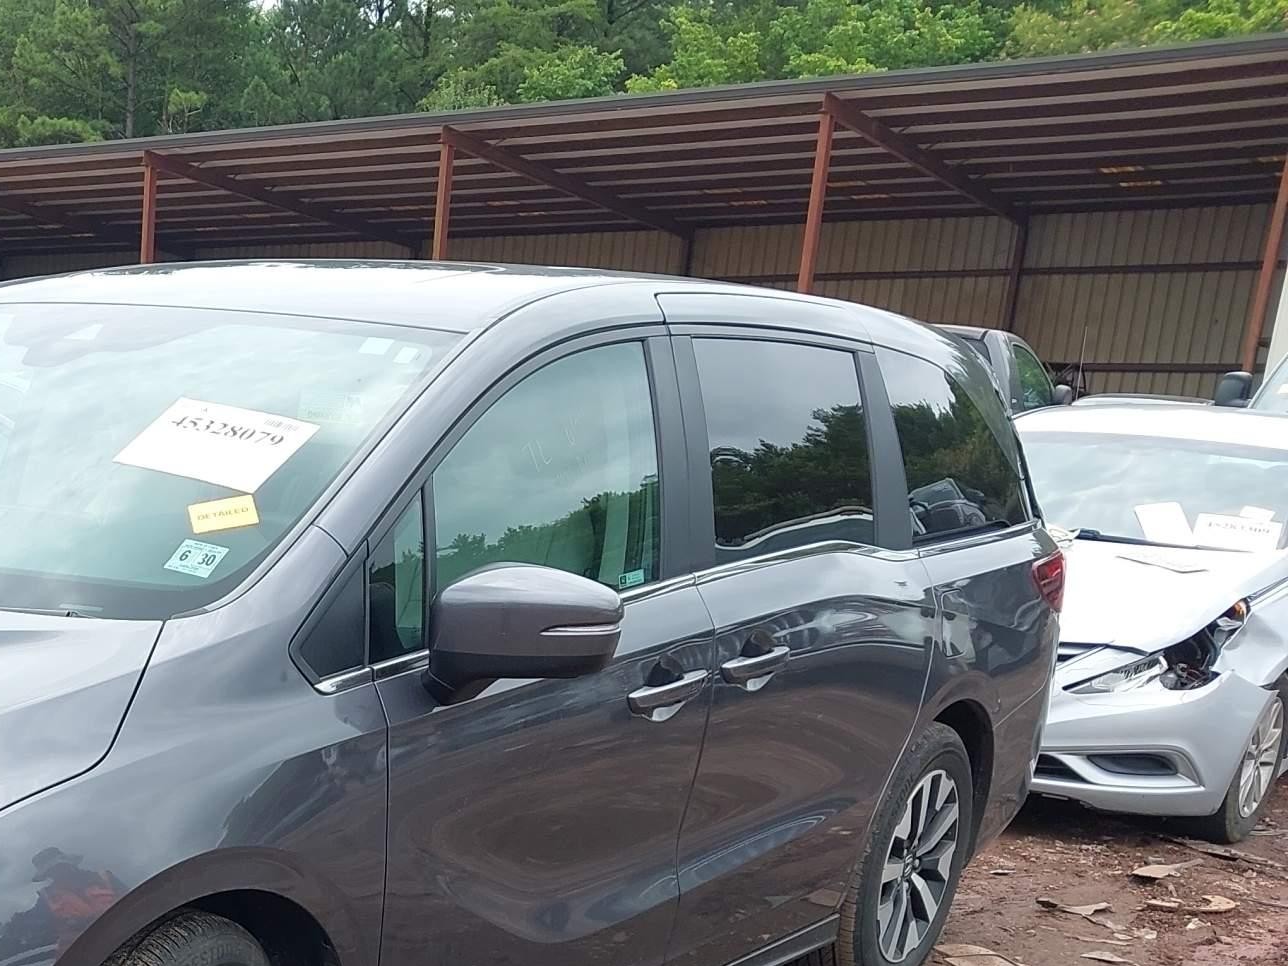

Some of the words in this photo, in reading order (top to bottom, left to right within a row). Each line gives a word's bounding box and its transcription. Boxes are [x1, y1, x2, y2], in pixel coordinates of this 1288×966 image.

[171, 415, 285, 446] 45328079
[197, 507, 249, 521] DETAILED
[179, 550, 192, 562] 6
[197, 553, 217, 566] 30
